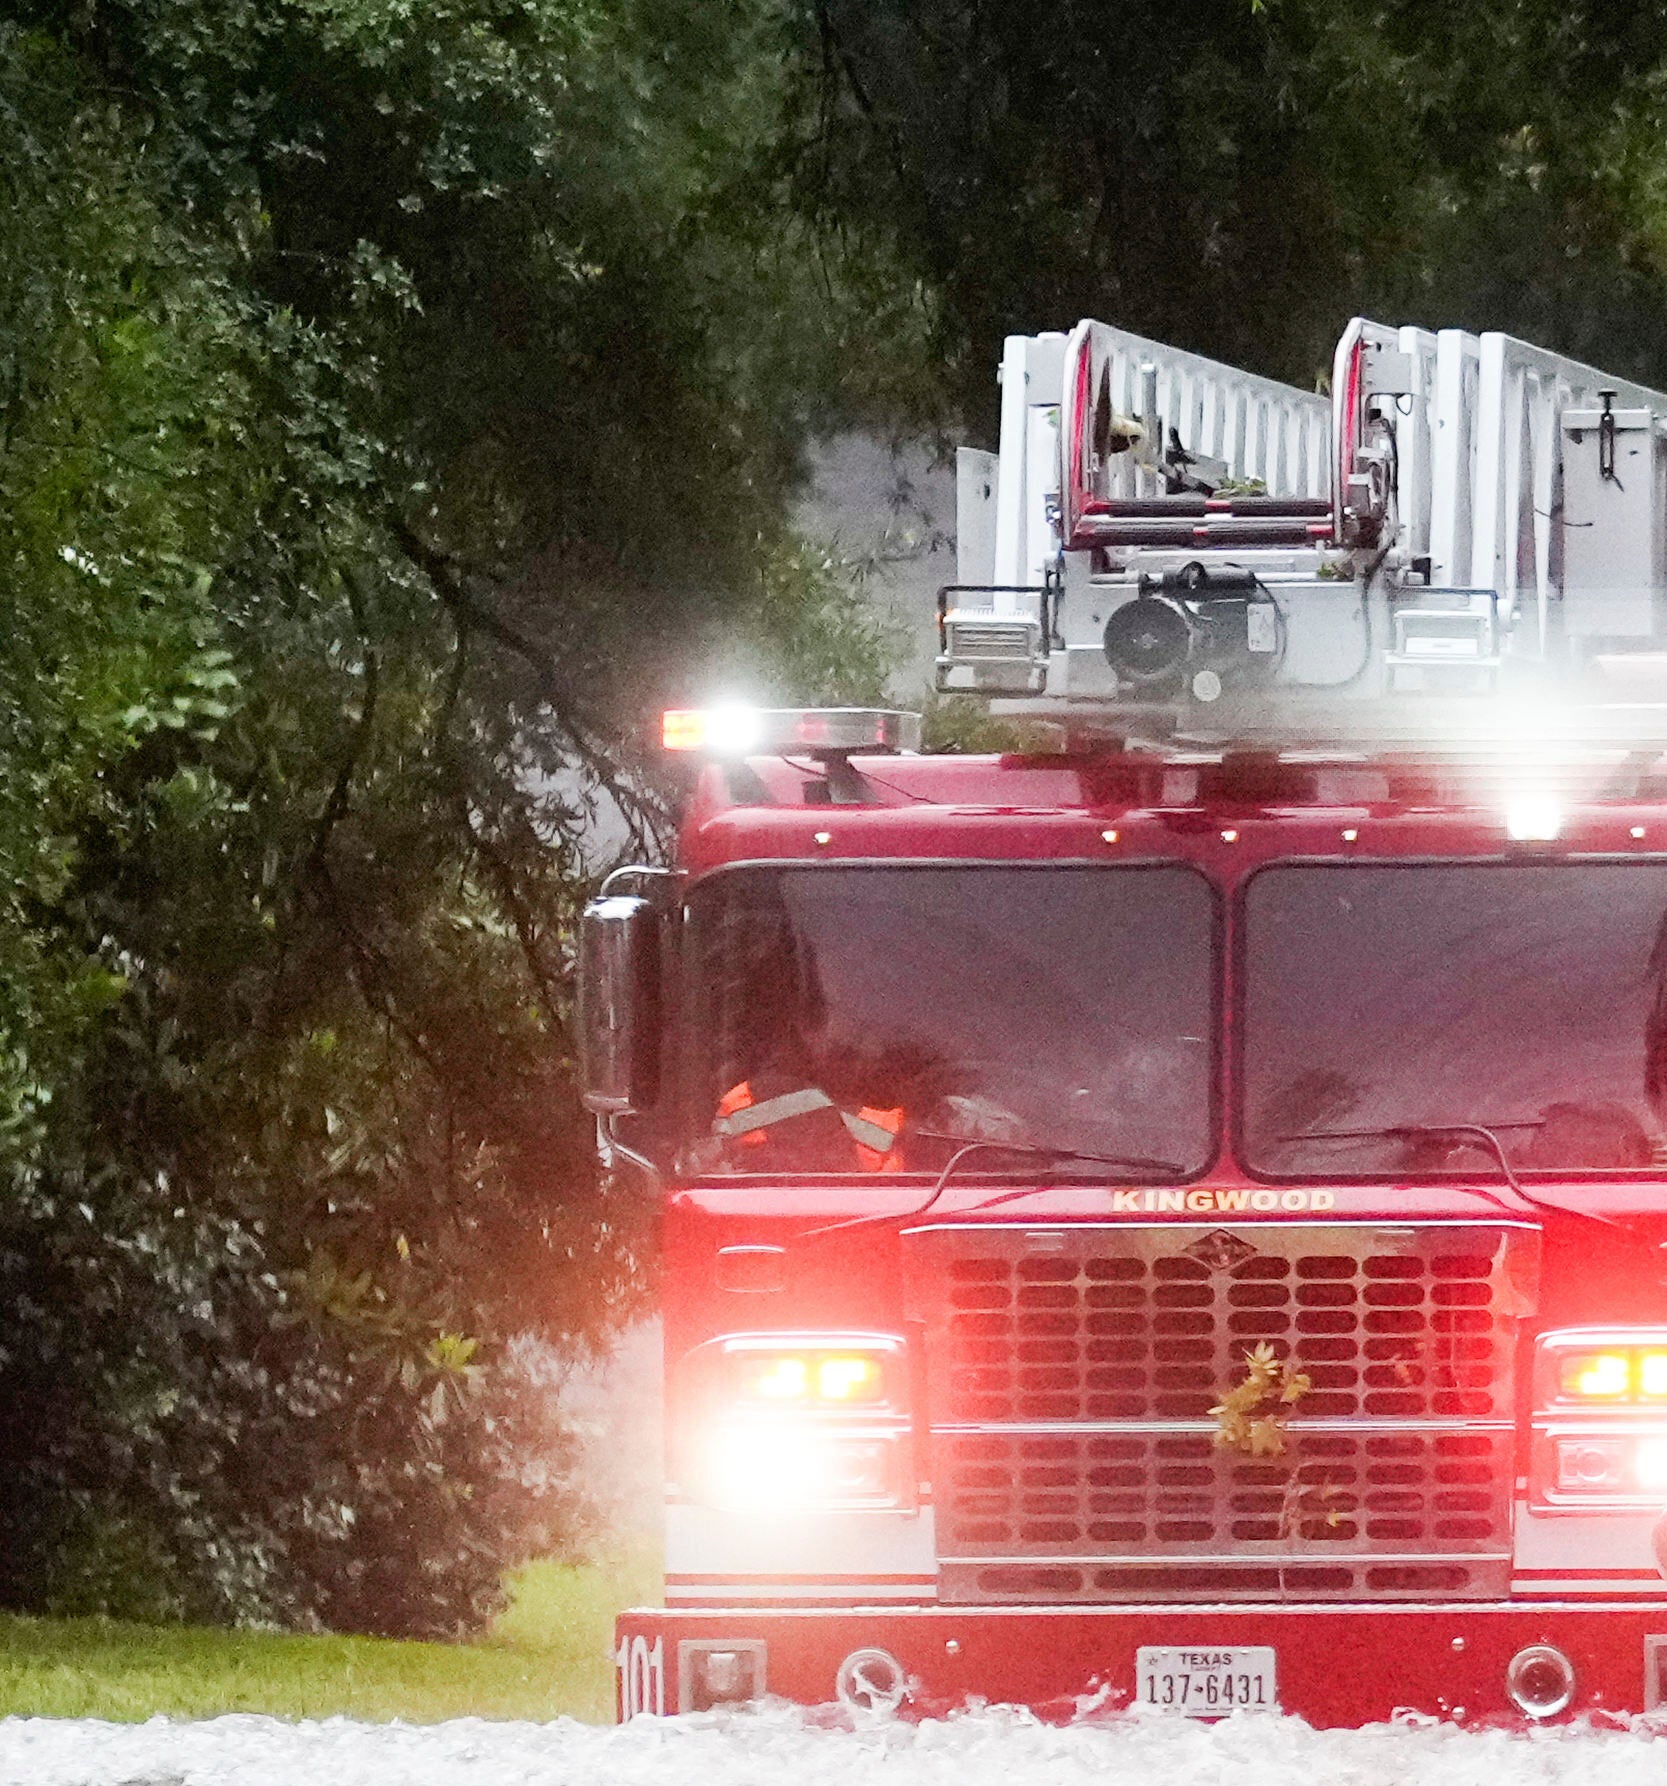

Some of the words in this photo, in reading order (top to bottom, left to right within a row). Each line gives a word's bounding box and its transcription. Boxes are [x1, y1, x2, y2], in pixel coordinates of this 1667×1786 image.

[1111, 1189, 1335, 1212] KINGWOOD
[1179, 1652, 1233, 1666] TEXAS
[616, 1635, 664, 1724] 101
